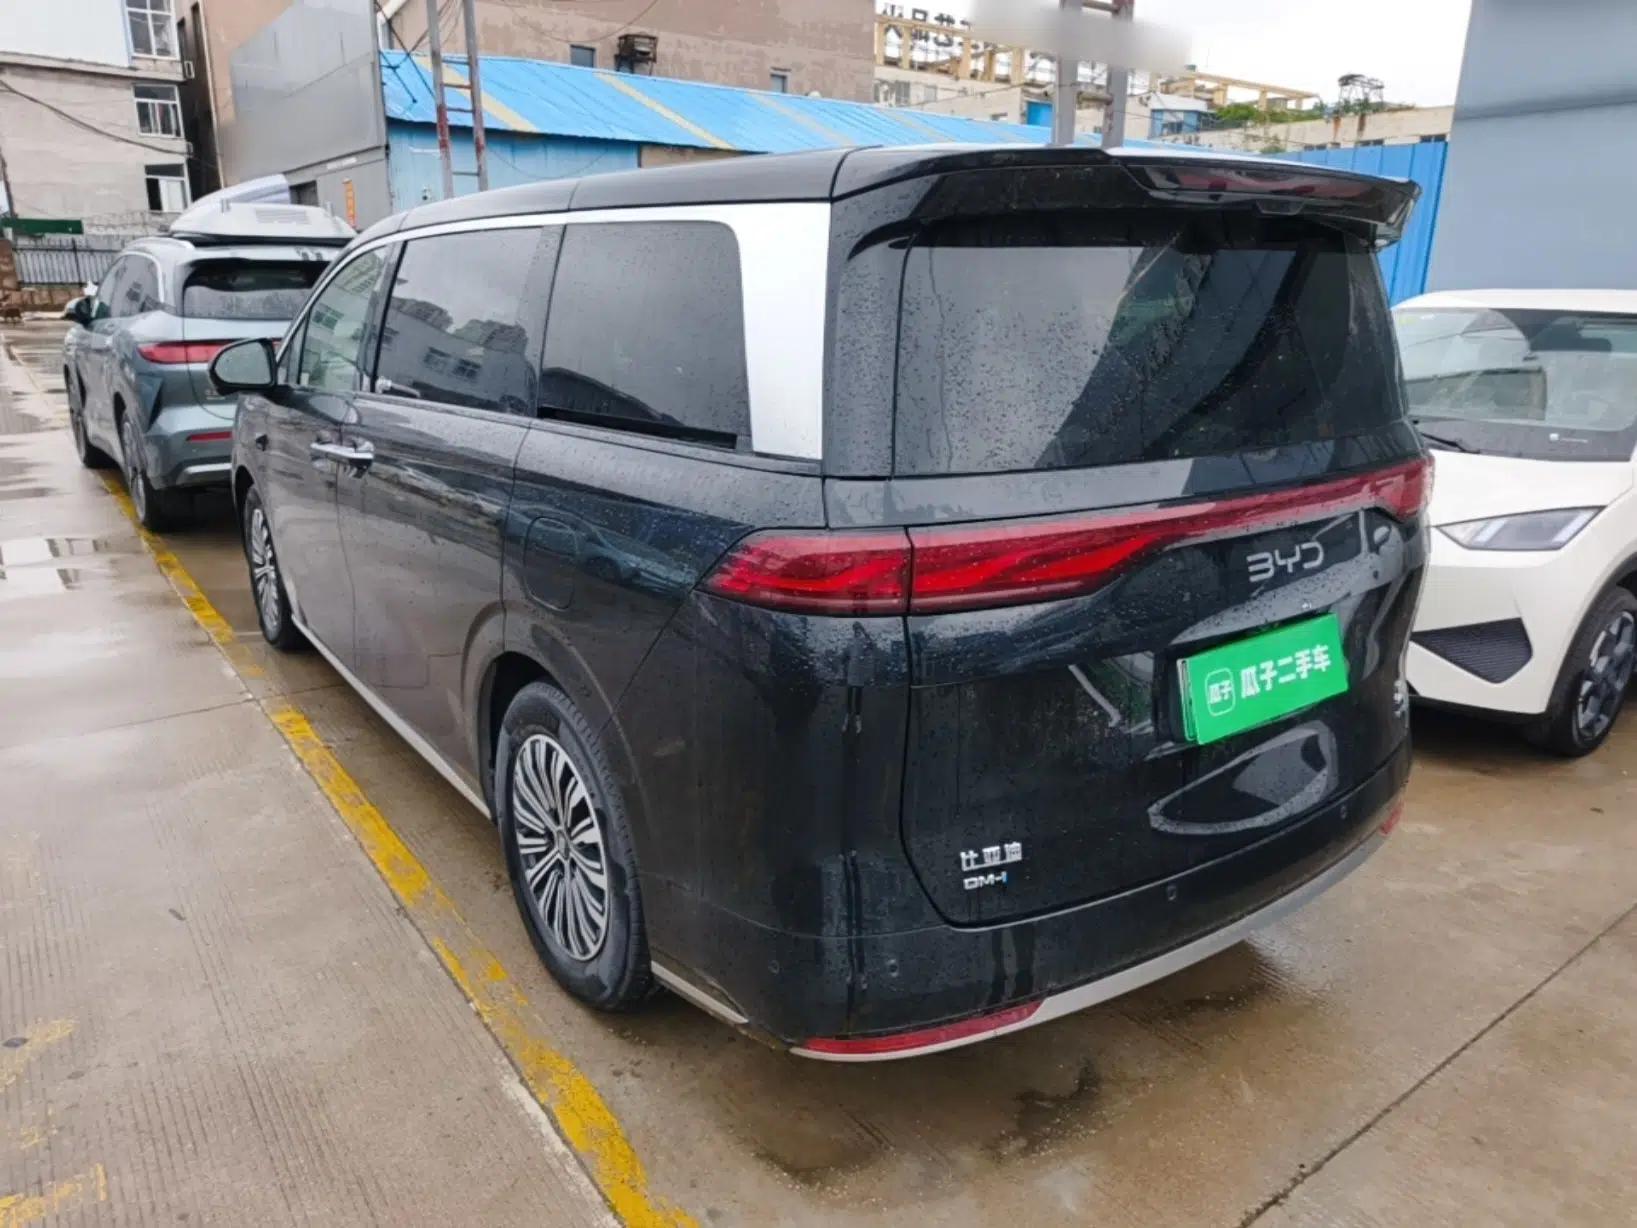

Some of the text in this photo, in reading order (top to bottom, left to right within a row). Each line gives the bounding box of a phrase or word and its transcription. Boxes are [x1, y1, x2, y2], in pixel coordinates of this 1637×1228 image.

[1246, 541, 1324, 582] BYD
[1241, 644, 1331, 698] 瓜子二手车
